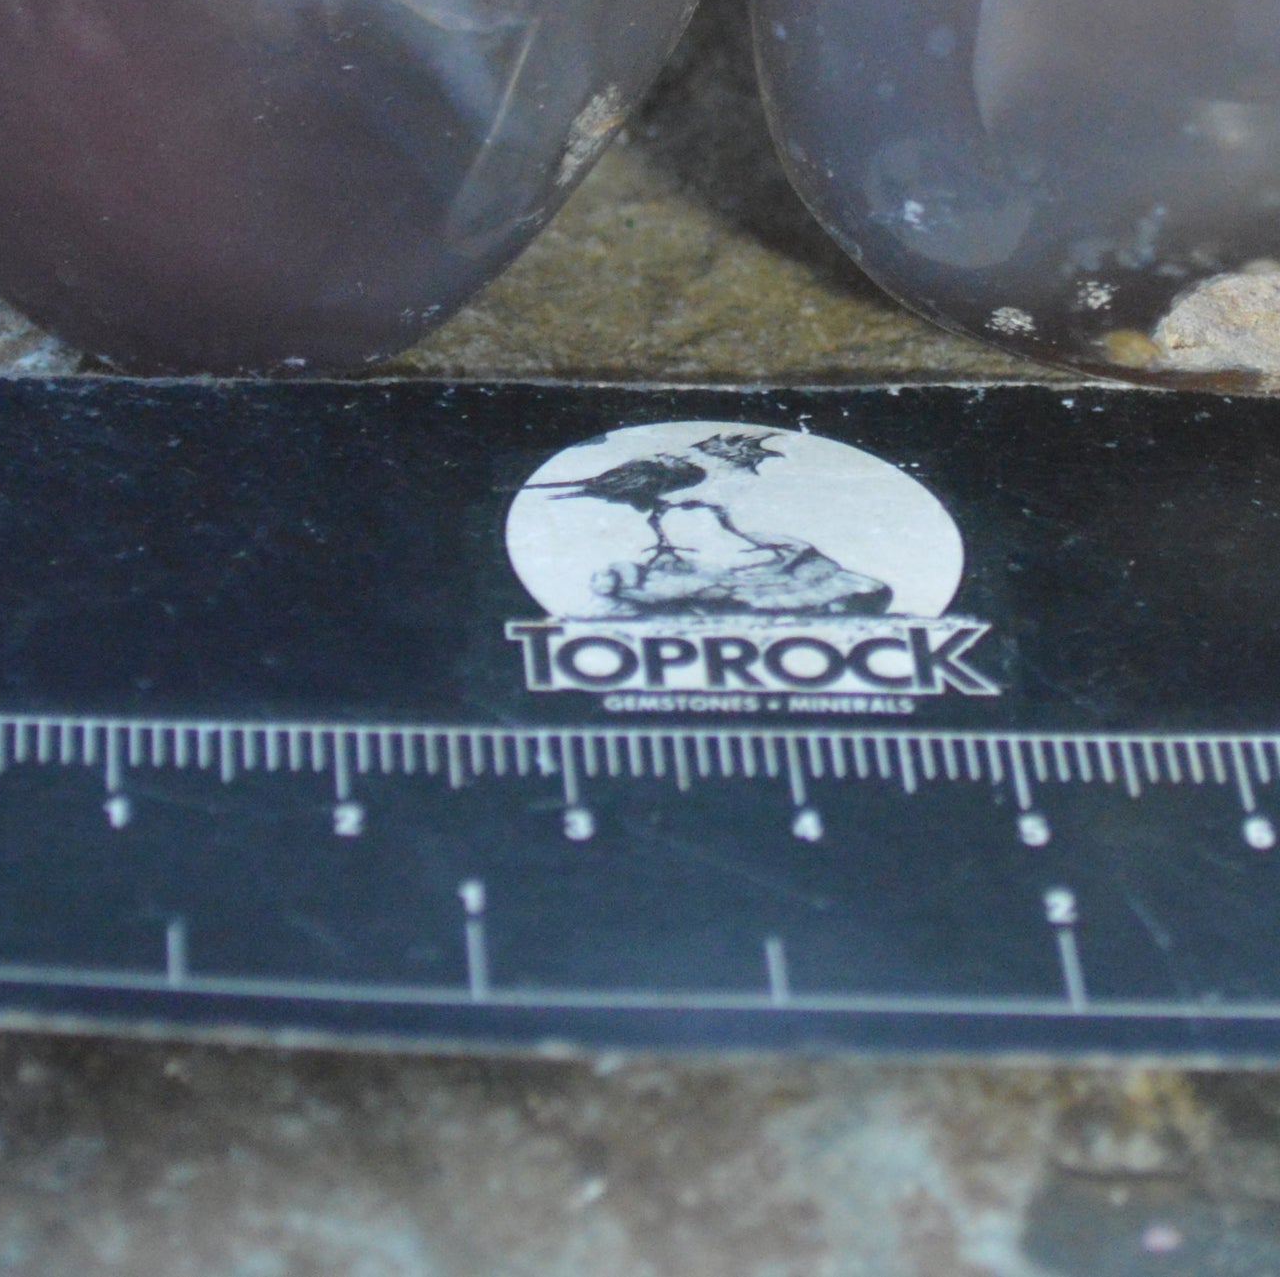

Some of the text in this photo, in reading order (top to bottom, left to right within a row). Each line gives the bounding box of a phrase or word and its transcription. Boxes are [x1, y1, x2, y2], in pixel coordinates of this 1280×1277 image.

[507, 622, 1001, 695] TOPROCK
[603, 694, 915, 714] GEMSTONES MINERALS
[104, 796, 129, 828] 1
[333, 804, 363, 836] 2
[564, 808, 594, 840] 3
[793, 810, 823, 841] 4
[1019, 814, 1050, 846] 5
[1243, 817, 1275, 849] 6
[459, 880, 485, 914] 1
[1045, 889, 1076, 924] 2
